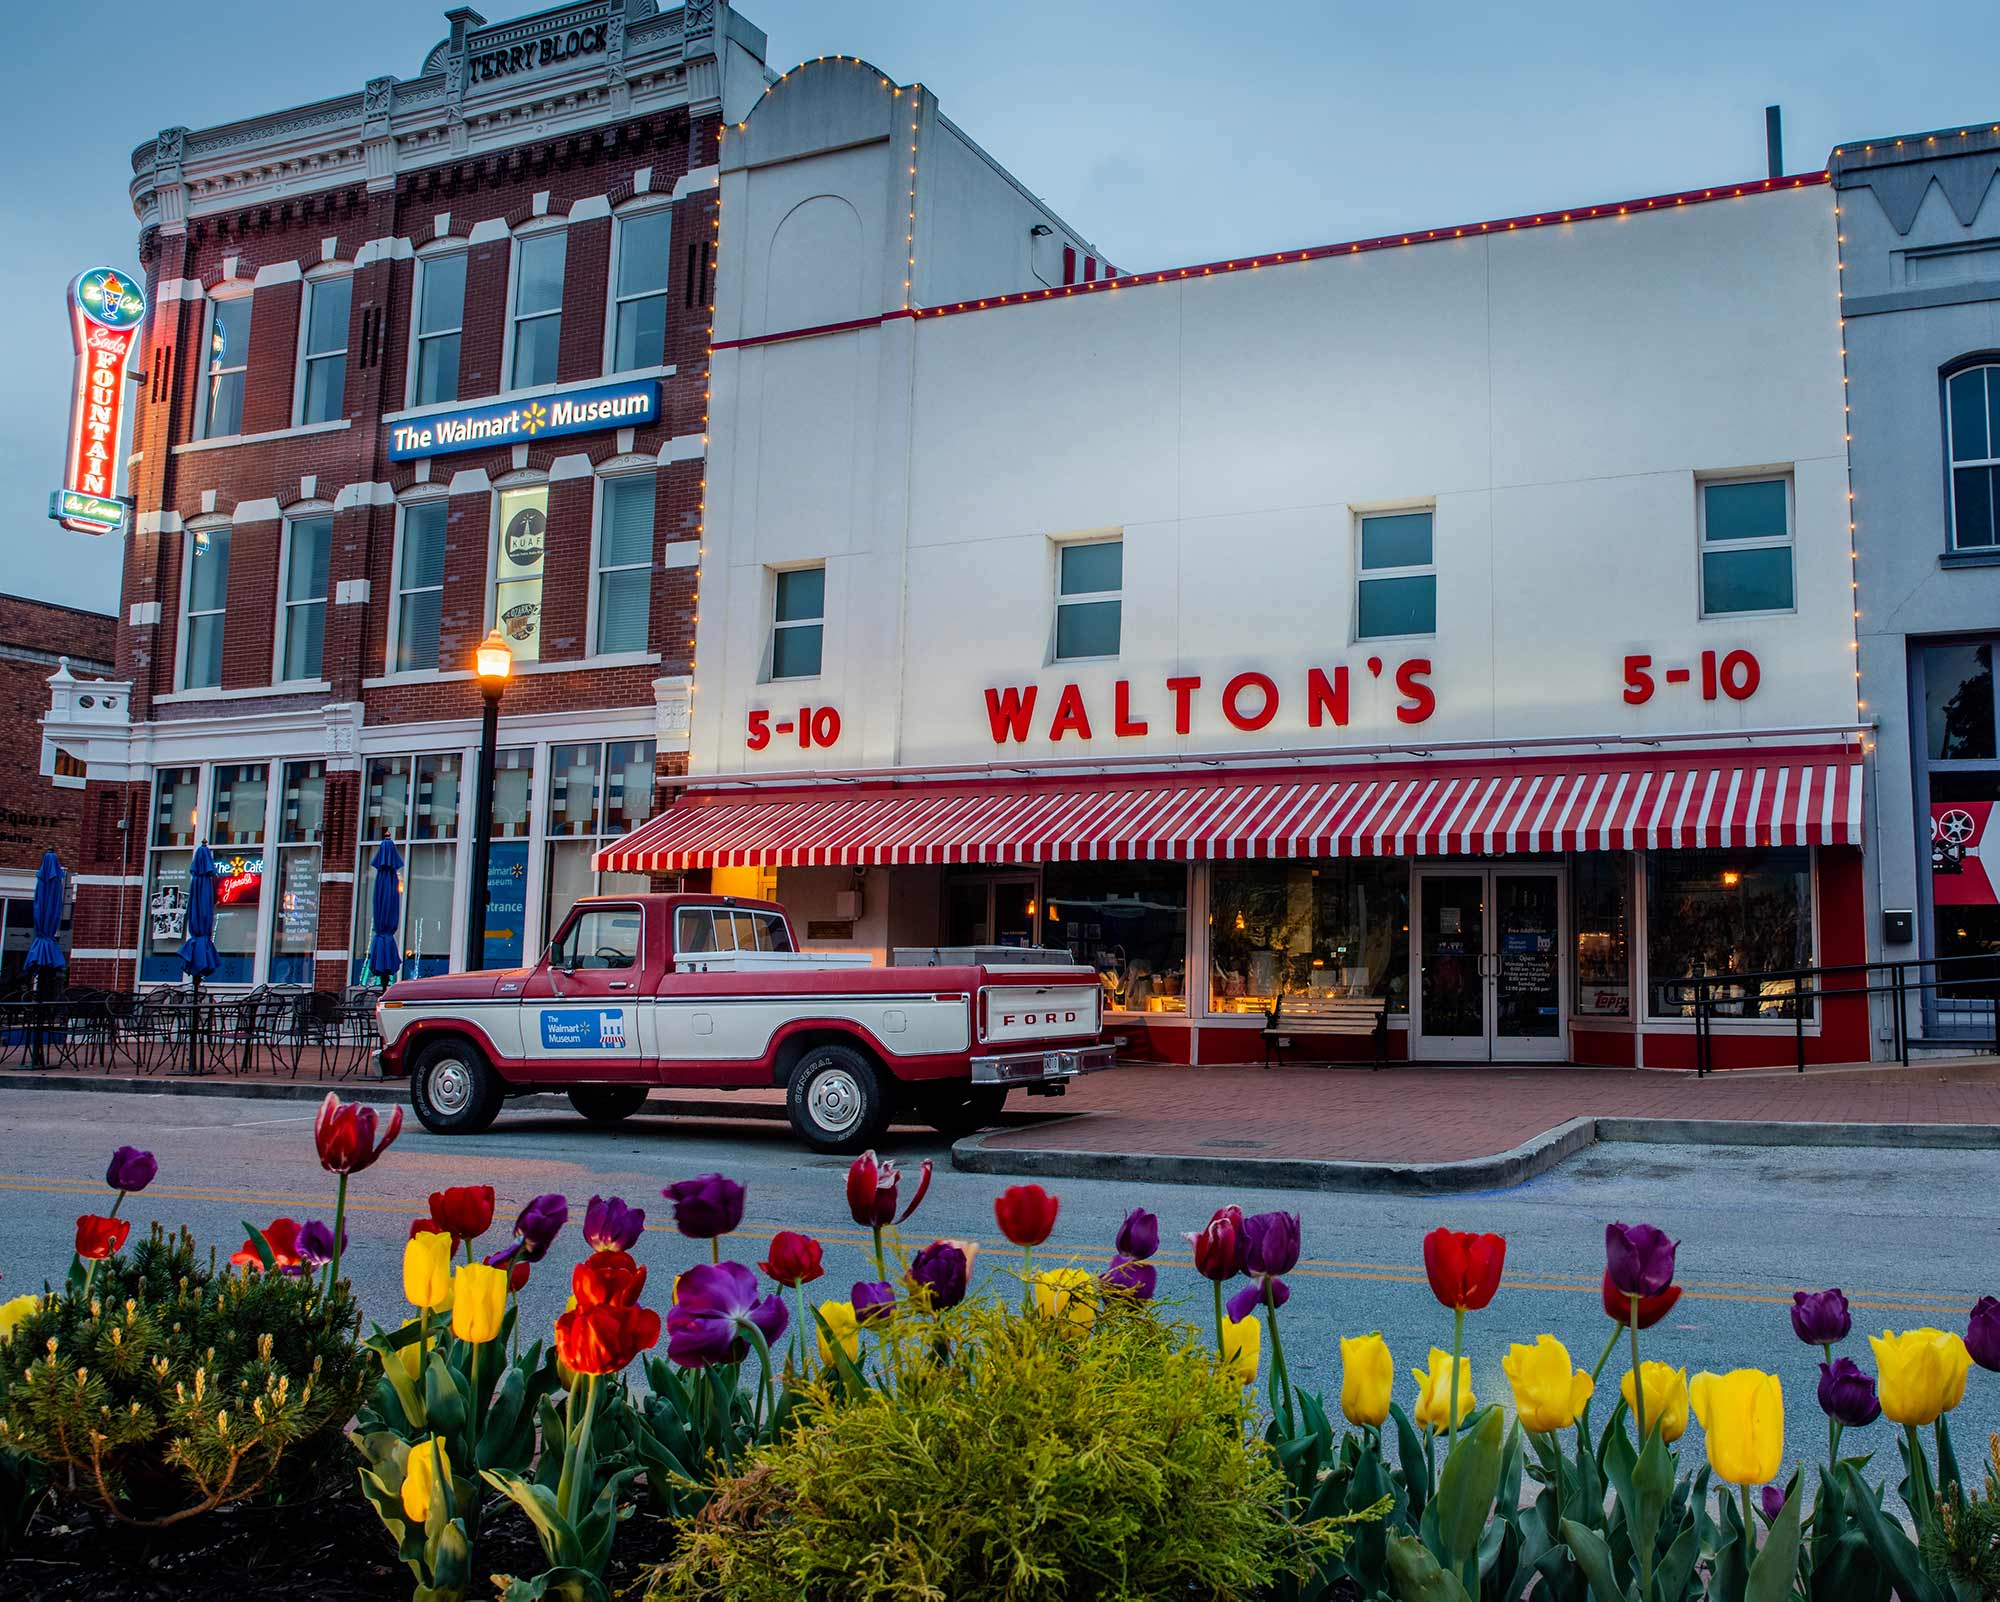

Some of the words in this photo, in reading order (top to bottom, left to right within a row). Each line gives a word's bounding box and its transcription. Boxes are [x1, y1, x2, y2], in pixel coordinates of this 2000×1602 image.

[469, 41, 538, 83] TERRY
[539, 22, 608, 65] BLOCK
[88, 328, 126, 355] Soda
[82, 349, 117, 494] FOUNTAIN
[393, 427, 432, 452] The
[436, 409, 520, 445] Walmart
[551, 393, 650, 427] Museum
[512, 536, 542, 549] KUAF
[1623, 649, 1761, 705] 5-10
[985, 656, 1436, 744] WALTON'S
[747, 706, 842, 751] 5-10
[214, 862, 231, 874] The
[487, 866, 512, 876] almart
[487, 878, 513, 886] useum
[486, 902, 523, 912] ntrance
[547, 1015, 559, 1023] The
[1003, 1012, 1076, 1026] FORD
[547, 1023, 580, 1033] Walmart
[548, 1034, 581, 1043] Museum
[795, 1057, 833, 1104] GENERAL
